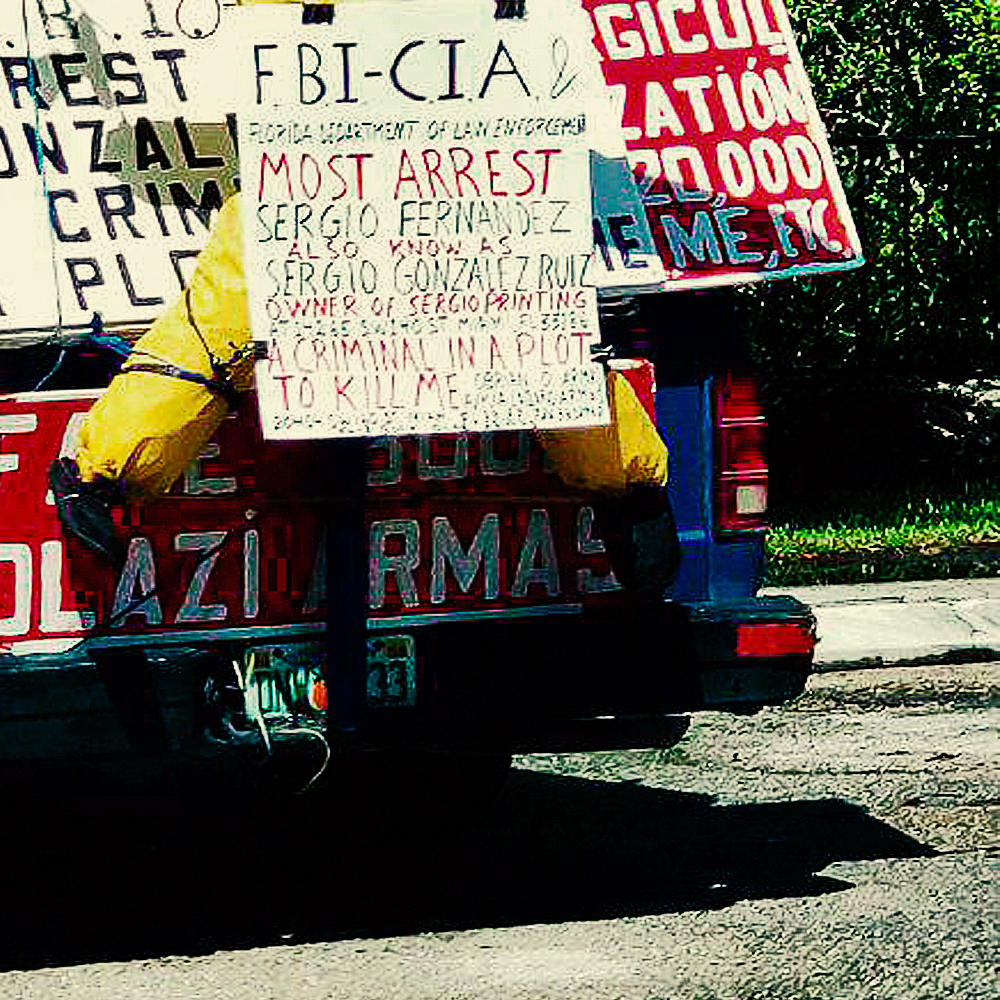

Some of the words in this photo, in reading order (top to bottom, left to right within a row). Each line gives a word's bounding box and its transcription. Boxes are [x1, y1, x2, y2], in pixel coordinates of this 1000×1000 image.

[258, 152, 374, 202] MOST
[393, 147, 562, 200] ARREST
[257, 203, 379, 243] SERGIO
[399, 200, 572, 237] FERNANDEZ
[265, 259, 377, 298] SERGIO
[538, 253, 597, 290] RUIZ
[409, 292, 480, 315] SERGIO
[516, 332, 593, 371] PLOT
[272, 375, 315, 411] TO
[414, 371, 460, 409] ME
